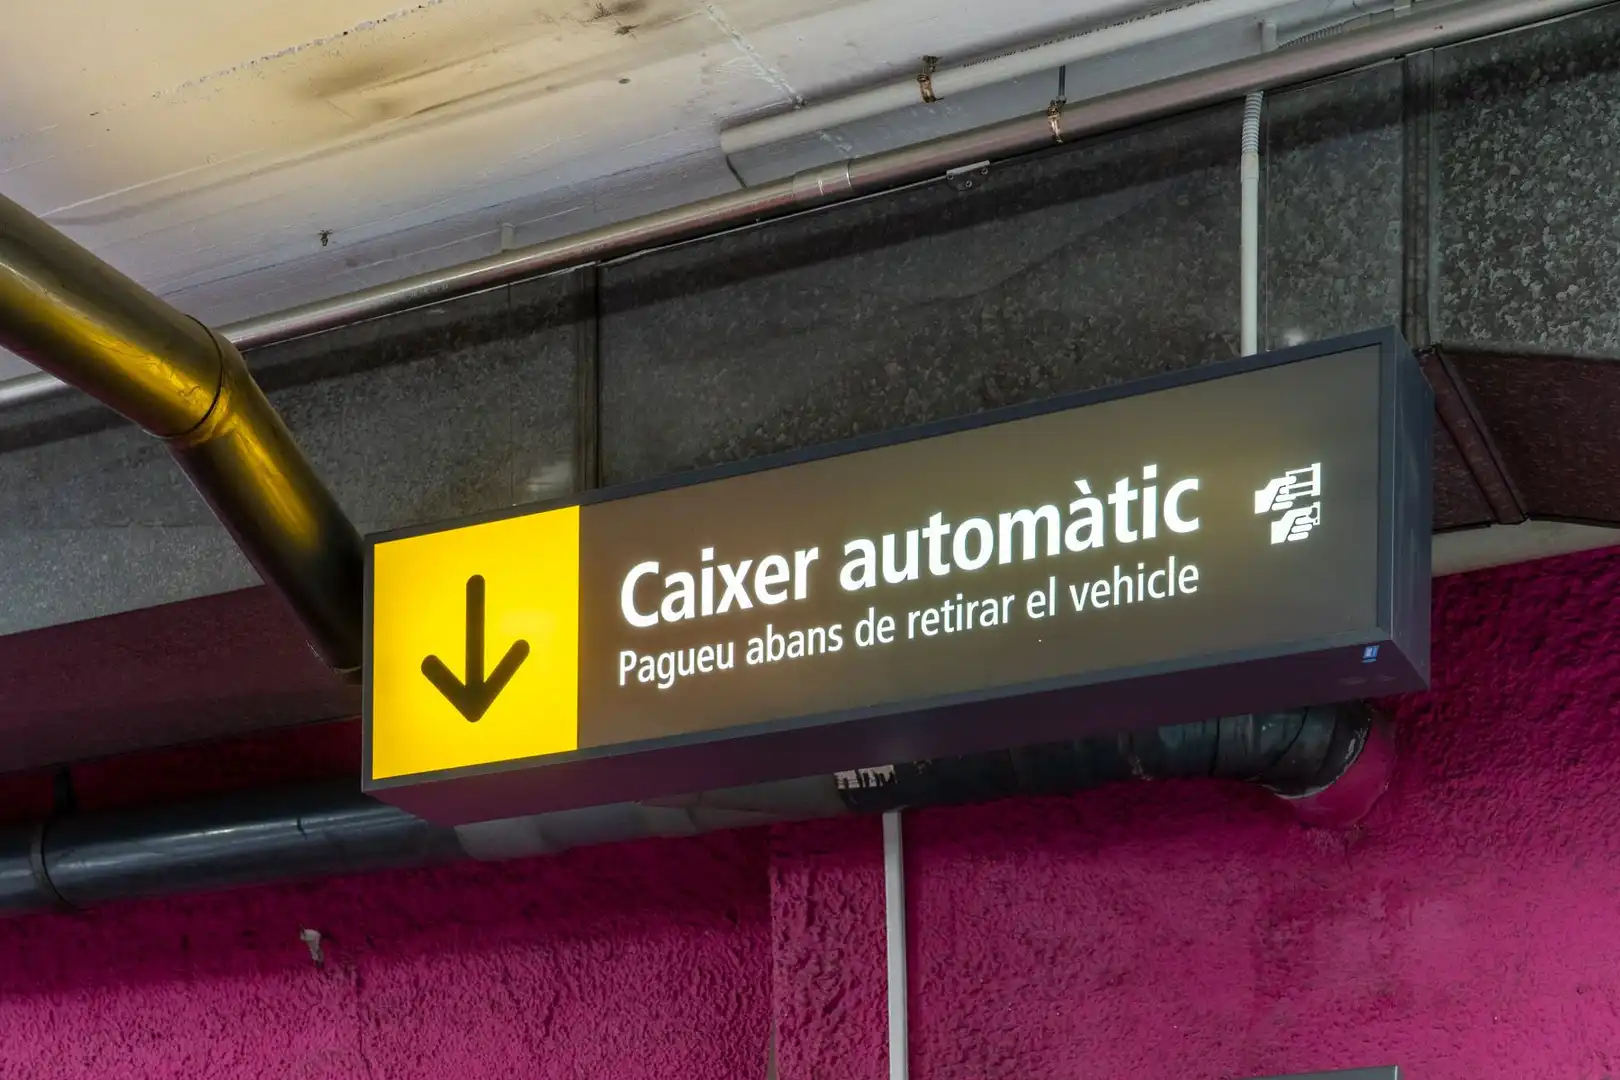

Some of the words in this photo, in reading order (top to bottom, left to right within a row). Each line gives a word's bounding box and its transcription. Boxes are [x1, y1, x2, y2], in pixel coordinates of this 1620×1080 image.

[620, 547, 819, 628] Caixer
[839, 463, 1200, 591] automàtic
[619, 642, 734, 690] Pagueu
[746, 624, 844, 665] abans
[855, 606, 896, 647] de
[908, 593, 1015, 639] retirar
[1026, 575, 1056, 619] el
[1069, 555, 1199, 612] vehicle
